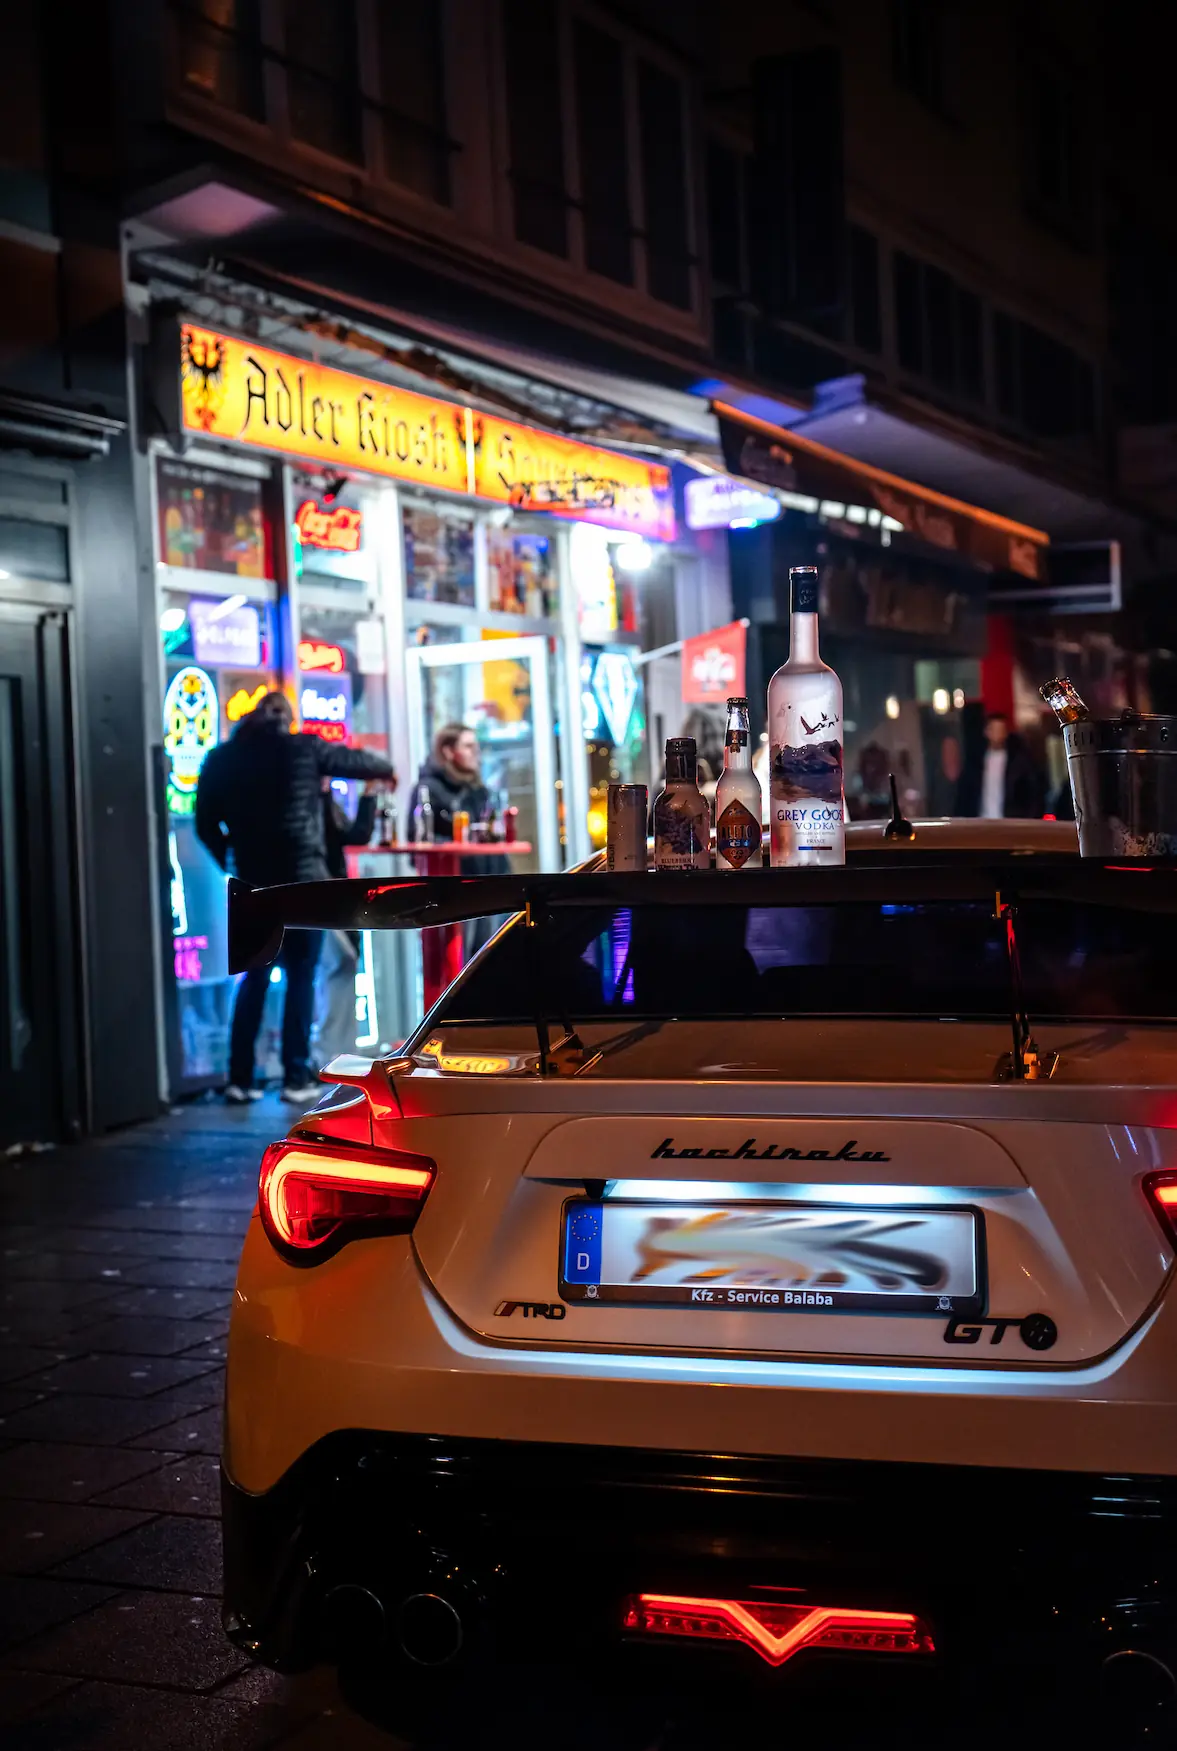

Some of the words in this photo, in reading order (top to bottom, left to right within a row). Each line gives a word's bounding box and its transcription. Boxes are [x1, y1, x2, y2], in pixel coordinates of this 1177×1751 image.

[240, 356, 342, 445] Adler
[357, 392, 447, 472] Kiosk
[777, 809, 807, 821] GREY
[795, 822, 835, 830] VODKA
[650, 1138, 892, 1162] hachiroku
[577, 1253, 590, 1270] D
[691, 1289, 713, 1301] Kfz
[727, 1290, 780, 1304] Service
[784, 1292, 833, 1306] Balaba
[508, 1301, 566, 1320] TRD
